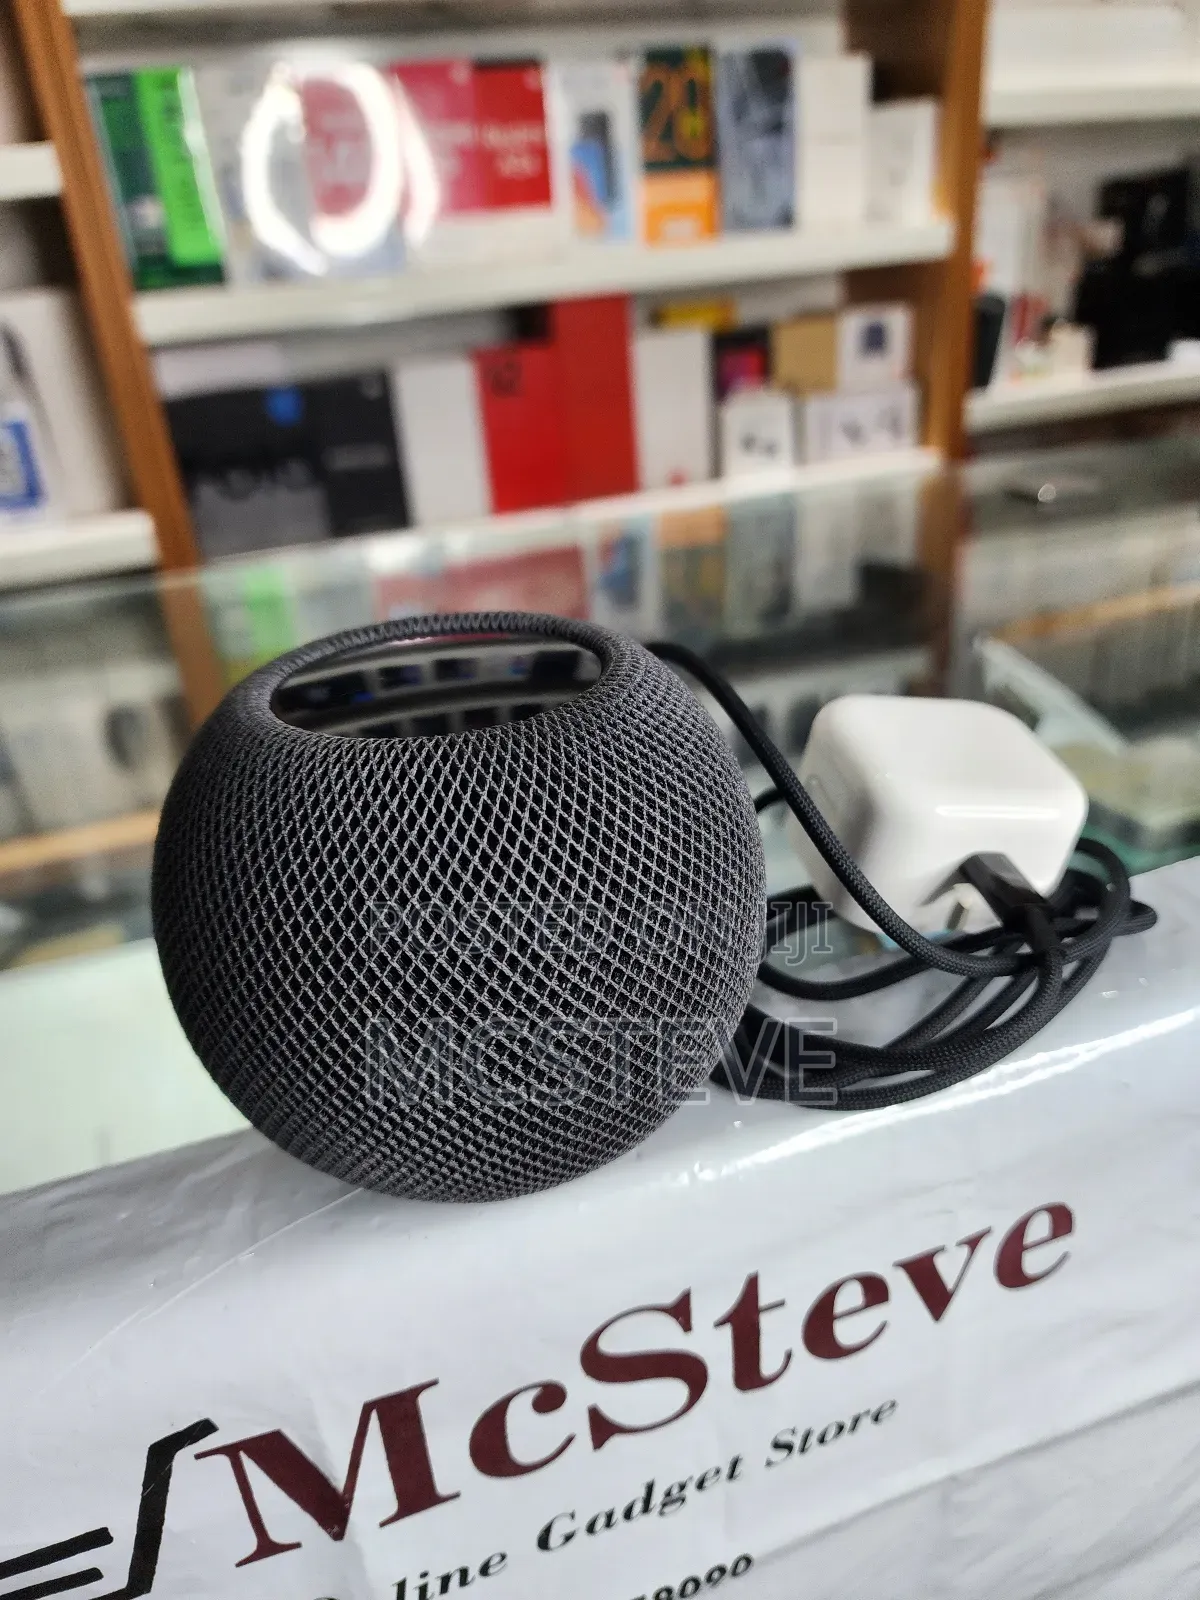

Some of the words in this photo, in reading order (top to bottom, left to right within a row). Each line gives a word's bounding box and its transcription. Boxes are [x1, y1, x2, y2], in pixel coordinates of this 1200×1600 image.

[194, 1202, 1075, 1567] McSteve
[536, 1453, 743, 1551] Gadget
[765, 1399, 897, 1468] Store
